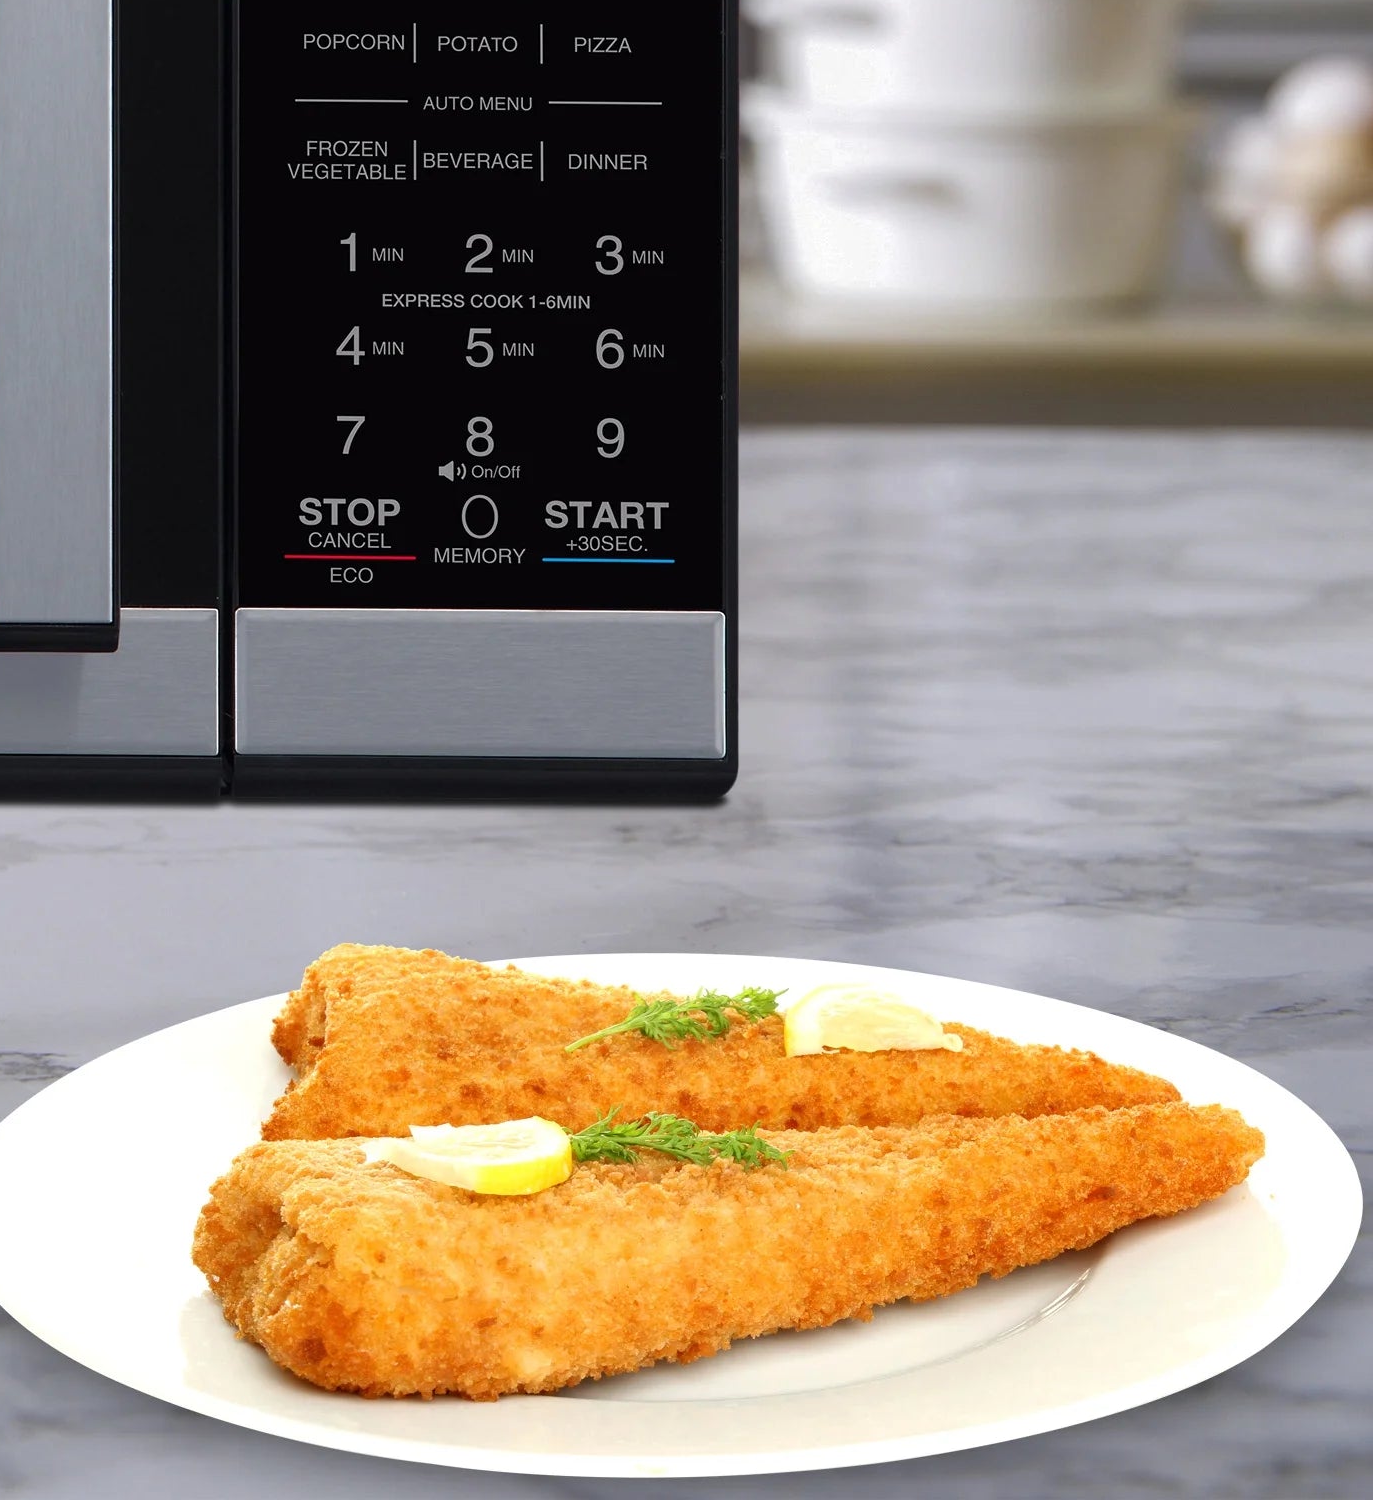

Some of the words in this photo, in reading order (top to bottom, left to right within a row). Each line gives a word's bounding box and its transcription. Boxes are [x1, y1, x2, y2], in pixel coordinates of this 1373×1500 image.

[304, 34, 404, 50] POPCORN
[438, 36, 517, 52] POTATO
[575, 37, 631, 52] PIZZA
[423, 96, 473, 110] AUTO
[480, 97, 532, 111] MENU
[307, 141, 387, 156] FROZEN
[424, 153, 533, 169] BEVERAGE
[569, 154, 647, 170] DINNER
[288, 163, 406, 180] VEGETABLE
[341, 233, 356, 271] 1
[373, 248, 403, 261] MIN
[465, 234, 493, 273] 2
[503, 249, 533, 262] MIN
[595, 235, 623, 275] 3
[633, 251, 663, 264] MIN
[383, 294, 465, 308] EXPRESS
[471, 294, 523, 308] COOK
[529, 295, 590, 309] 1-6MIN
[336, 326, 365, 365] 4
[373, 341, 403, 355] MIN
[466, 328, 493, 367] 5
[503, 343, 534, 356] MIN
[596, 329, 624, 369] 6
[634, 344, 664, 358] MIN
[337, 416, 365, 454] 7
[466, 417, 494, 457] 8
[597, 418, 624, 458] 9
[472, 465, 520, 478] On/Off
[299, 498, 400, 526] STOP
[545, 500, 669, 529] START
[309, 532, 391, 548] CANCEL
[567, 536, 647, 551] +30SEC.
[435, 548, 525, 563] MEMORY
[331, 567, 373, 583] ECO
